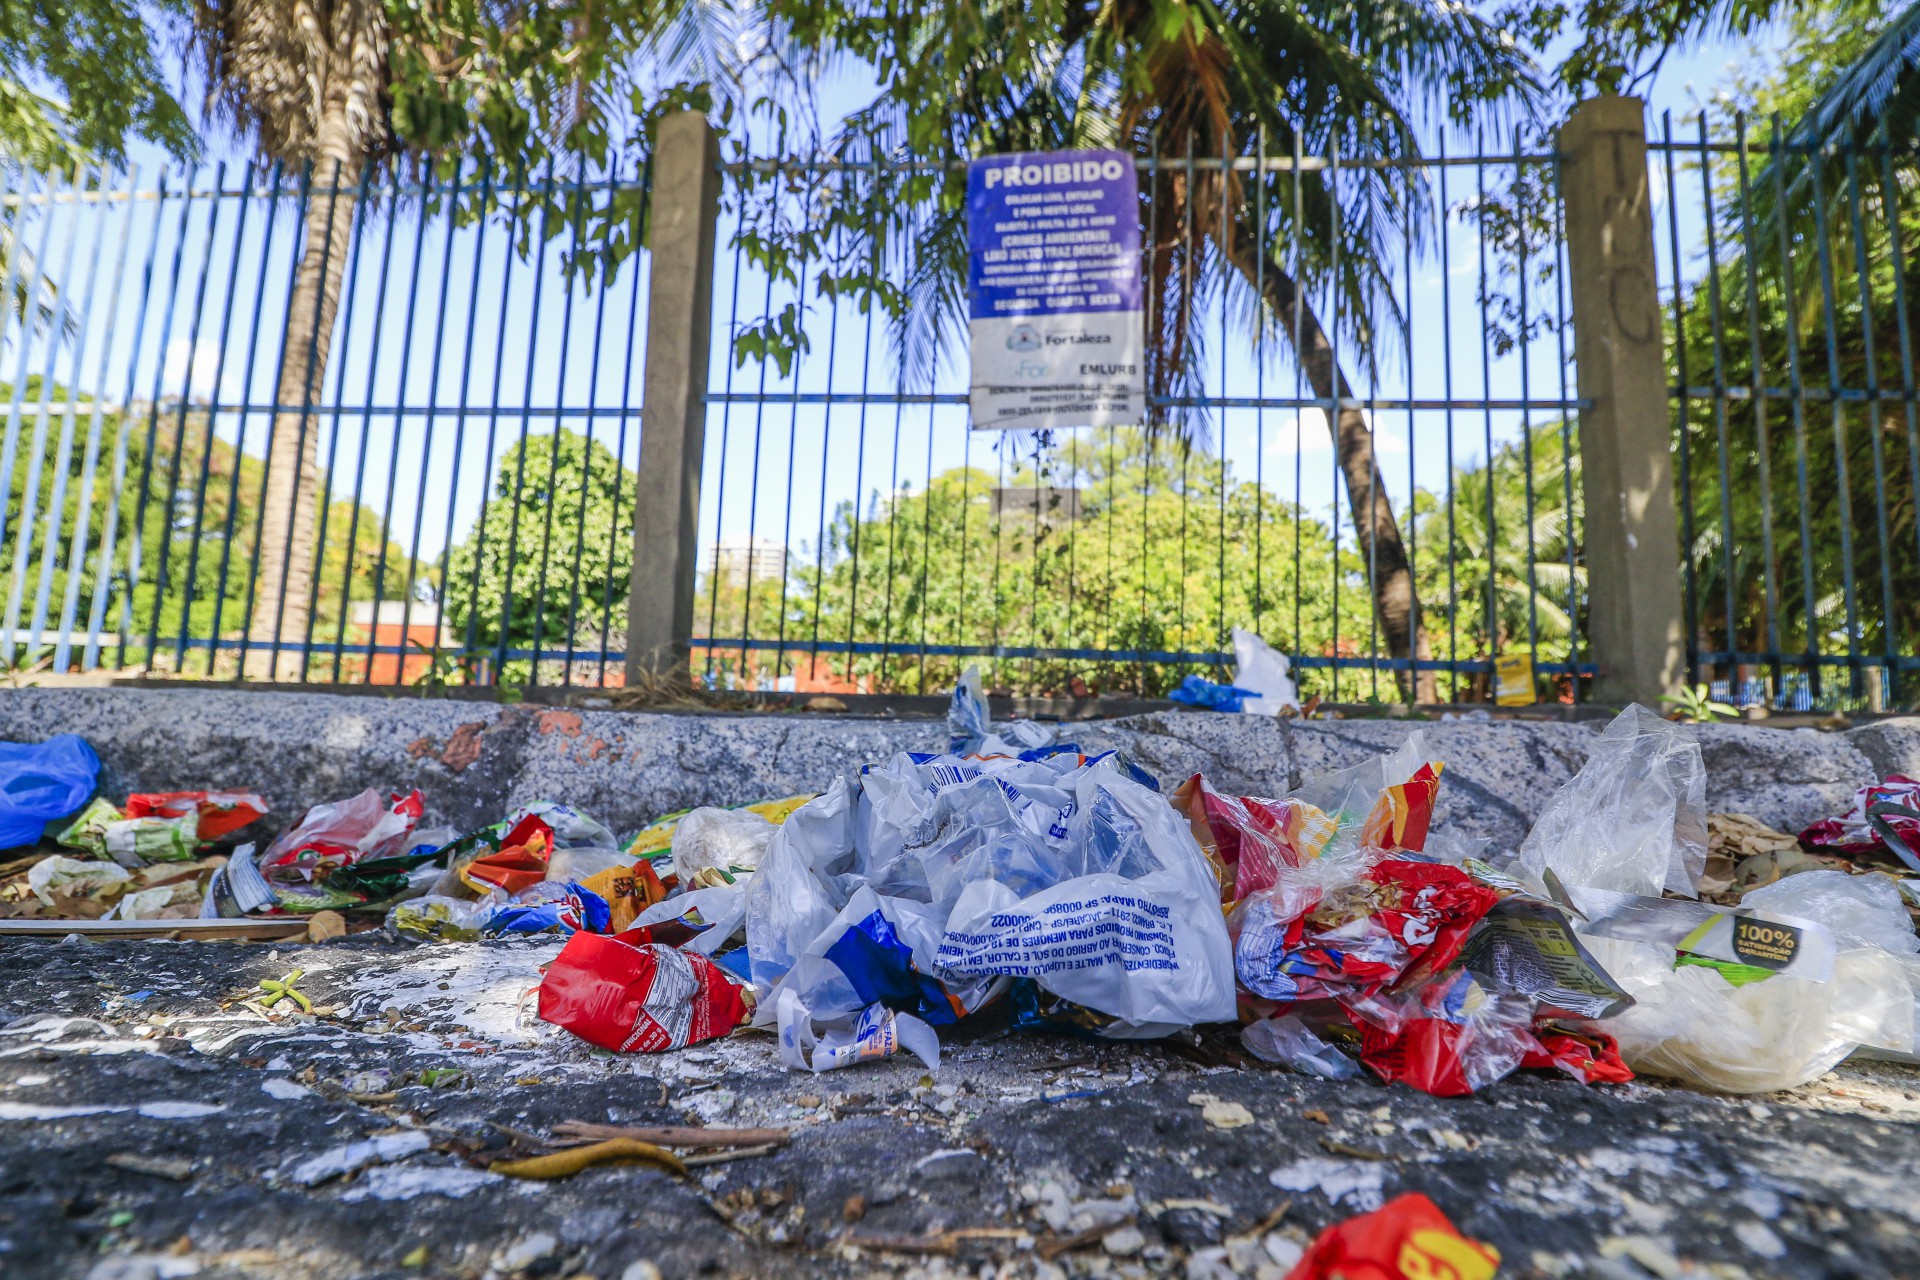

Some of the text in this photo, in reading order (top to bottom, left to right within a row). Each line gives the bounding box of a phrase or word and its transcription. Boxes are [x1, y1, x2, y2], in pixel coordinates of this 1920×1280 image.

[985, 160, 1124, 189] PROIBIDO
[1045, 334, 1111, 345] Fortaleza
[1080, 363, 1137, 375] EMLURB
[1085, 899, 1098, 908] SP
[1101, 895, 1135, 906] MAPA:
[1111, 907, 1130, 920] 2911
[1132, 912, 1155, 929] BRANCO,
[1071, 927, 1093, 940] PARA
[1135, 931, 1168, 943] CONSUMO
[1738, 924, 1795, 948] 100%
[1006, 938, 1019, 948] DE
[1022, 932, 1066, 947] MENORES
[1100, 938, 1109, 948] AO
[1169, 937, 1173, 945] E
[1052, 948, 1063, 957] DO
[1066, 942, 1097, 956] ABRIGO
[1738, 939, 1792, 956] SATISFAÇÃO
[985, 952, 1020, 962] CALOR,
[1024, 952, 1029, 960] E
[1032, 950, 1049, 960] SOL
[1738, 946, 1788, 962] GARANTIDA
[969, 956, 982, 965] EM
[1067, 961, 1073, 969] E
[1075, 957, 1103, 969] MALTE
